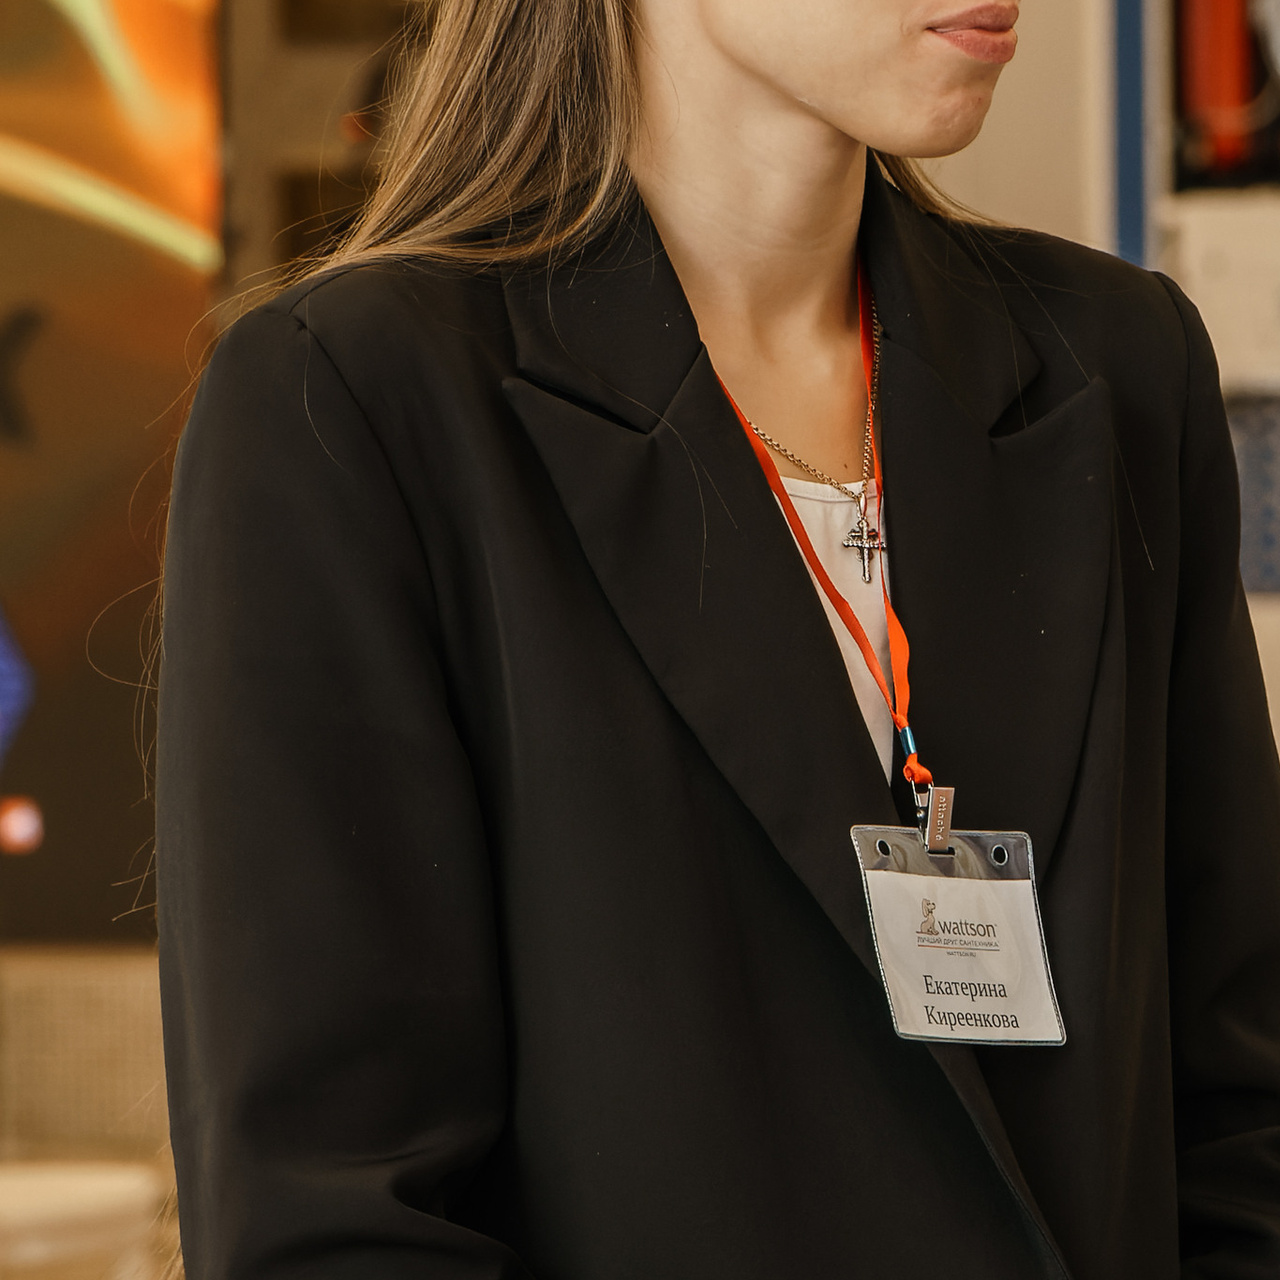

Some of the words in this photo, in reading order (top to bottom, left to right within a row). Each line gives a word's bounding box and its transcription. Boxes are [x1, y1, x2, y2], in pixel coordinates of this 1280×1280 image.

[938, 919, 997, 938] wattson
[923, 974, 1008, 1002] Екатерина
[923, 1005, 1020, 1031] Киреенкова
